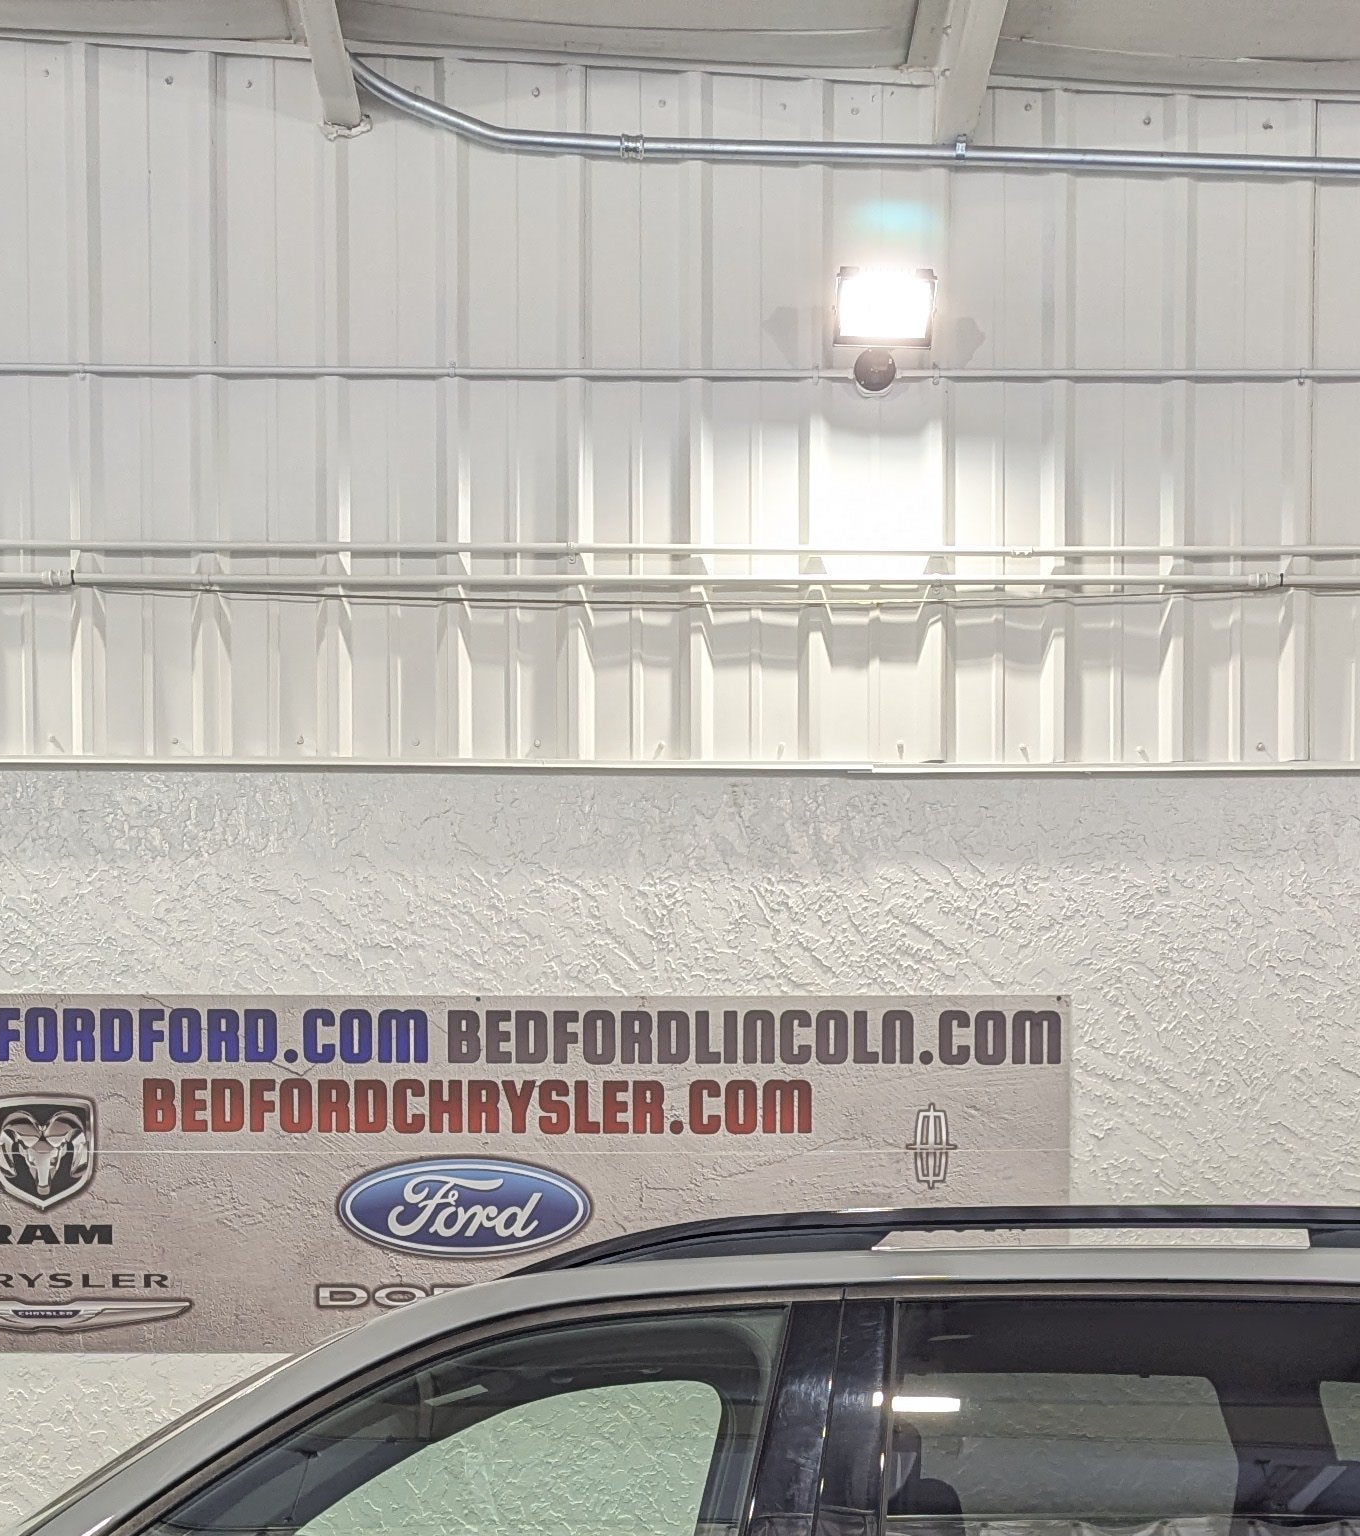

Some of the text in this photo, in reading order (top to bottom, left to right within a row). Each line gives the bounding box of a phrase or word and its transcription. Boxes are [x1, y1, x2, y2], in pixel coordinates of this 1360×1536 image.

[447, 1009, 1062, 1065] BEDFORDLINCOLN.COM
[143, 1077, 812, 1134] BEDFORDCHRYSLER.COM
[387, 1174, 543, 1238] Ford
[317, 1286, 463, 1307] DO
